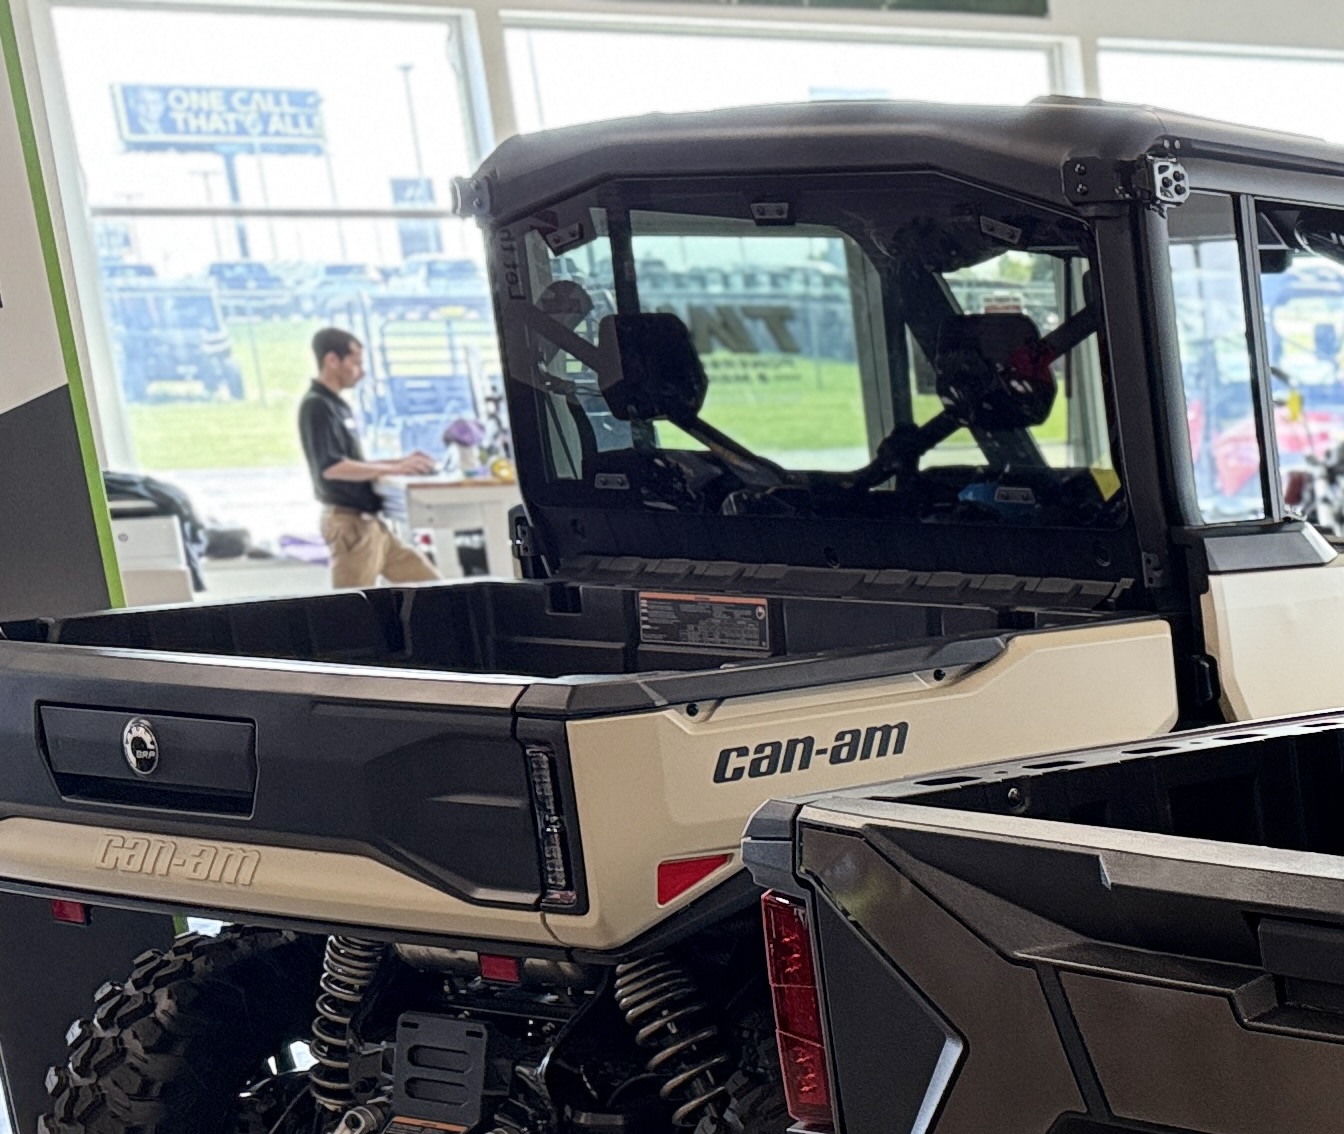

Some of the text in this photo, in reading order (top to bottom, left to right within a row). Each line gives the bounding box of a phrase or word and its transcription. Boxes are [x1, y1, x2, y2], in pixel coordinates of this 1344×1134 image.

[167, 88, 225, 112] ONE
[135, 748, 156, 760] BRP
[713, 721, 909, 784] can-am
[96, 833, 261, 887] can-am
